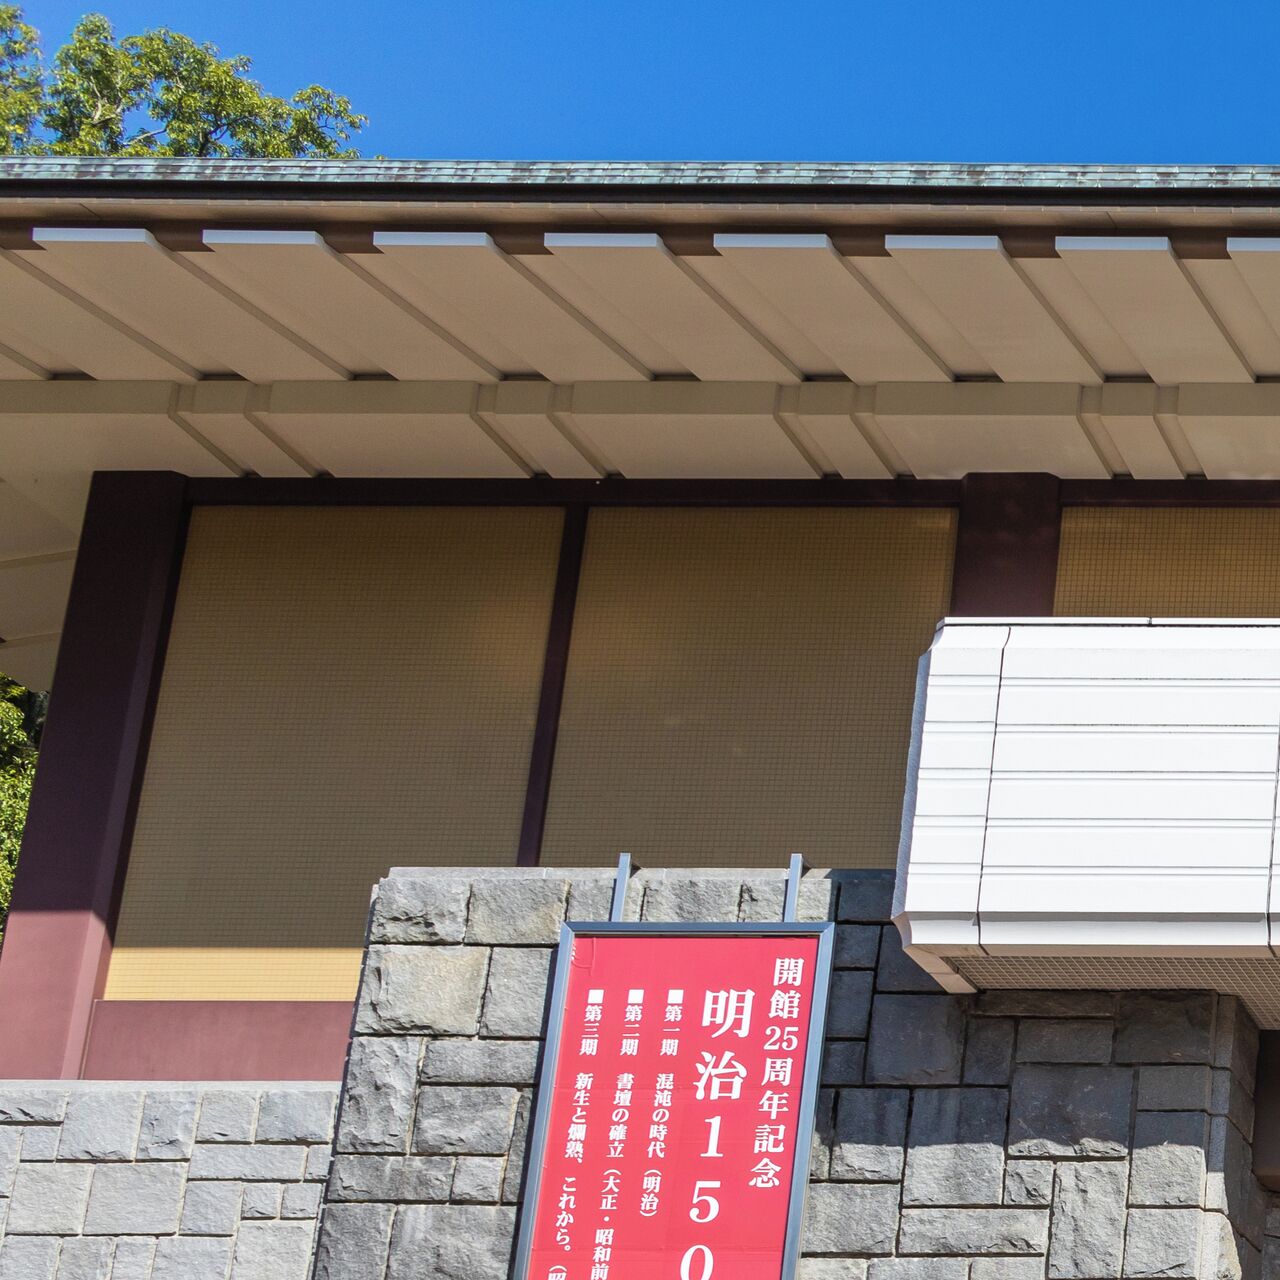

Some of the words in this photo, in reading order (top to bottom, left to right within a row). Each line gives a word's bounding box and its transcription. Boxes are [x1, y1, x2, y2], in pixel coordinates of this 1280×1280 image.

[579, 1004, 603, 1056] 第三期
[620, 1004, 643, 1056] 第二期
[660, 1004, 683, 1056] 第一期
[748, 957, 804, 1188] 開館25周年記念
